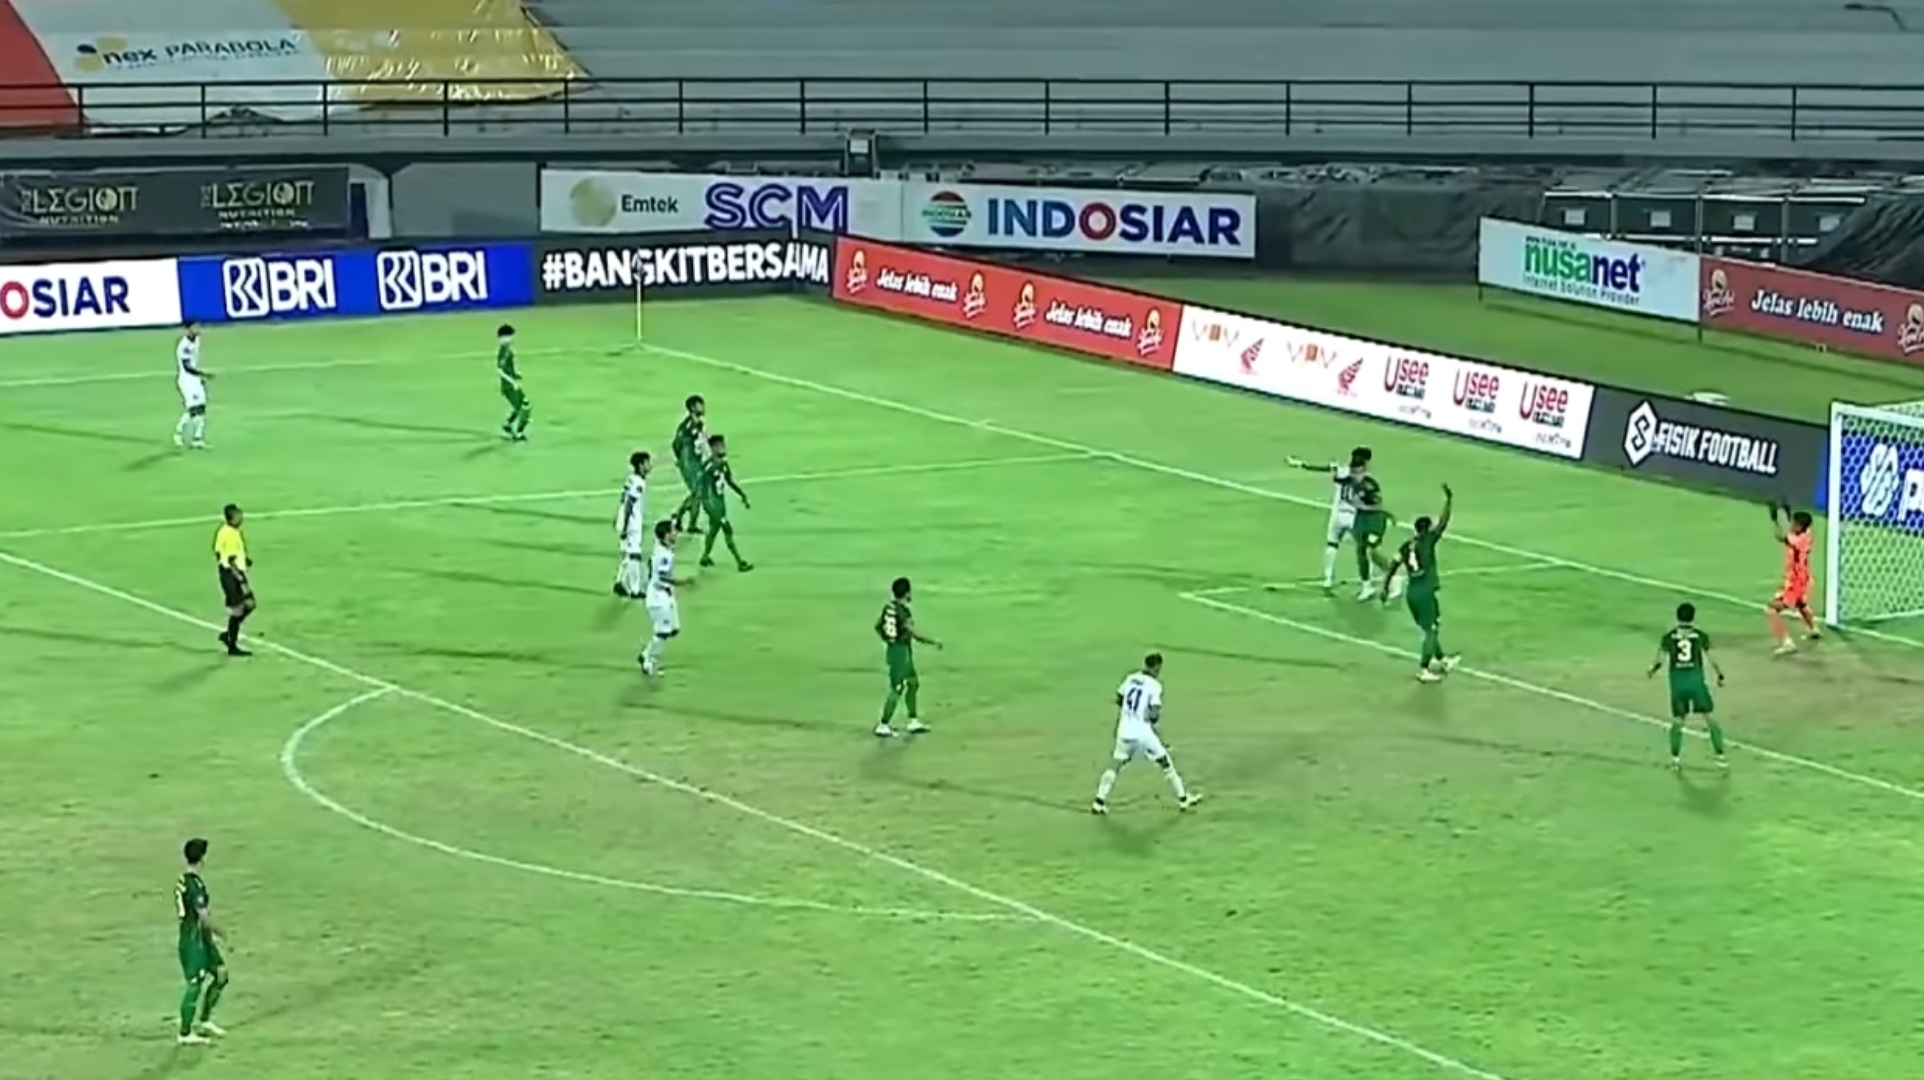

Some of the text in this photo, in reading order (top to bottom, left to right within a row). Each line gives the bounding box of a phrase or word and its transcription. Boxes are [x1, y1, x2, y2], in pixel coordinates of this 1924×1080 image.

[165, 37, 296, 57] PARABOLA
[621, 194, 679, 214] Emtek
[704, 183, 849, 233] SCM
[988, 198, 1241, 246] INDOSIAR
[268, 258, 337, 312] BRI
[422, 250, 488, 302] BRI
[542, 242, 829, 291] #BANGKITBERSAMA
[876, 268, 904, 291] Jelas
[1525, 244, 1640, 294] nusanet
[0, 275, 131, 320] OSIAR
[1046, 300, 1075, 325] Jelas
[1751, 289, 1793, 316] Jelas
[1798, 298, 1839, 325] lebih
[1843, 311, 1885, 333] enak
[1384, 355, 1430, 393] Usee
[1453, 368, 1499, 407] Usee
[1519, 381, 1569, 421] Usee
[1659, 422, 1778, 474] FISIK FOOTBALL
[1677, 638, 1692, 662] 3
